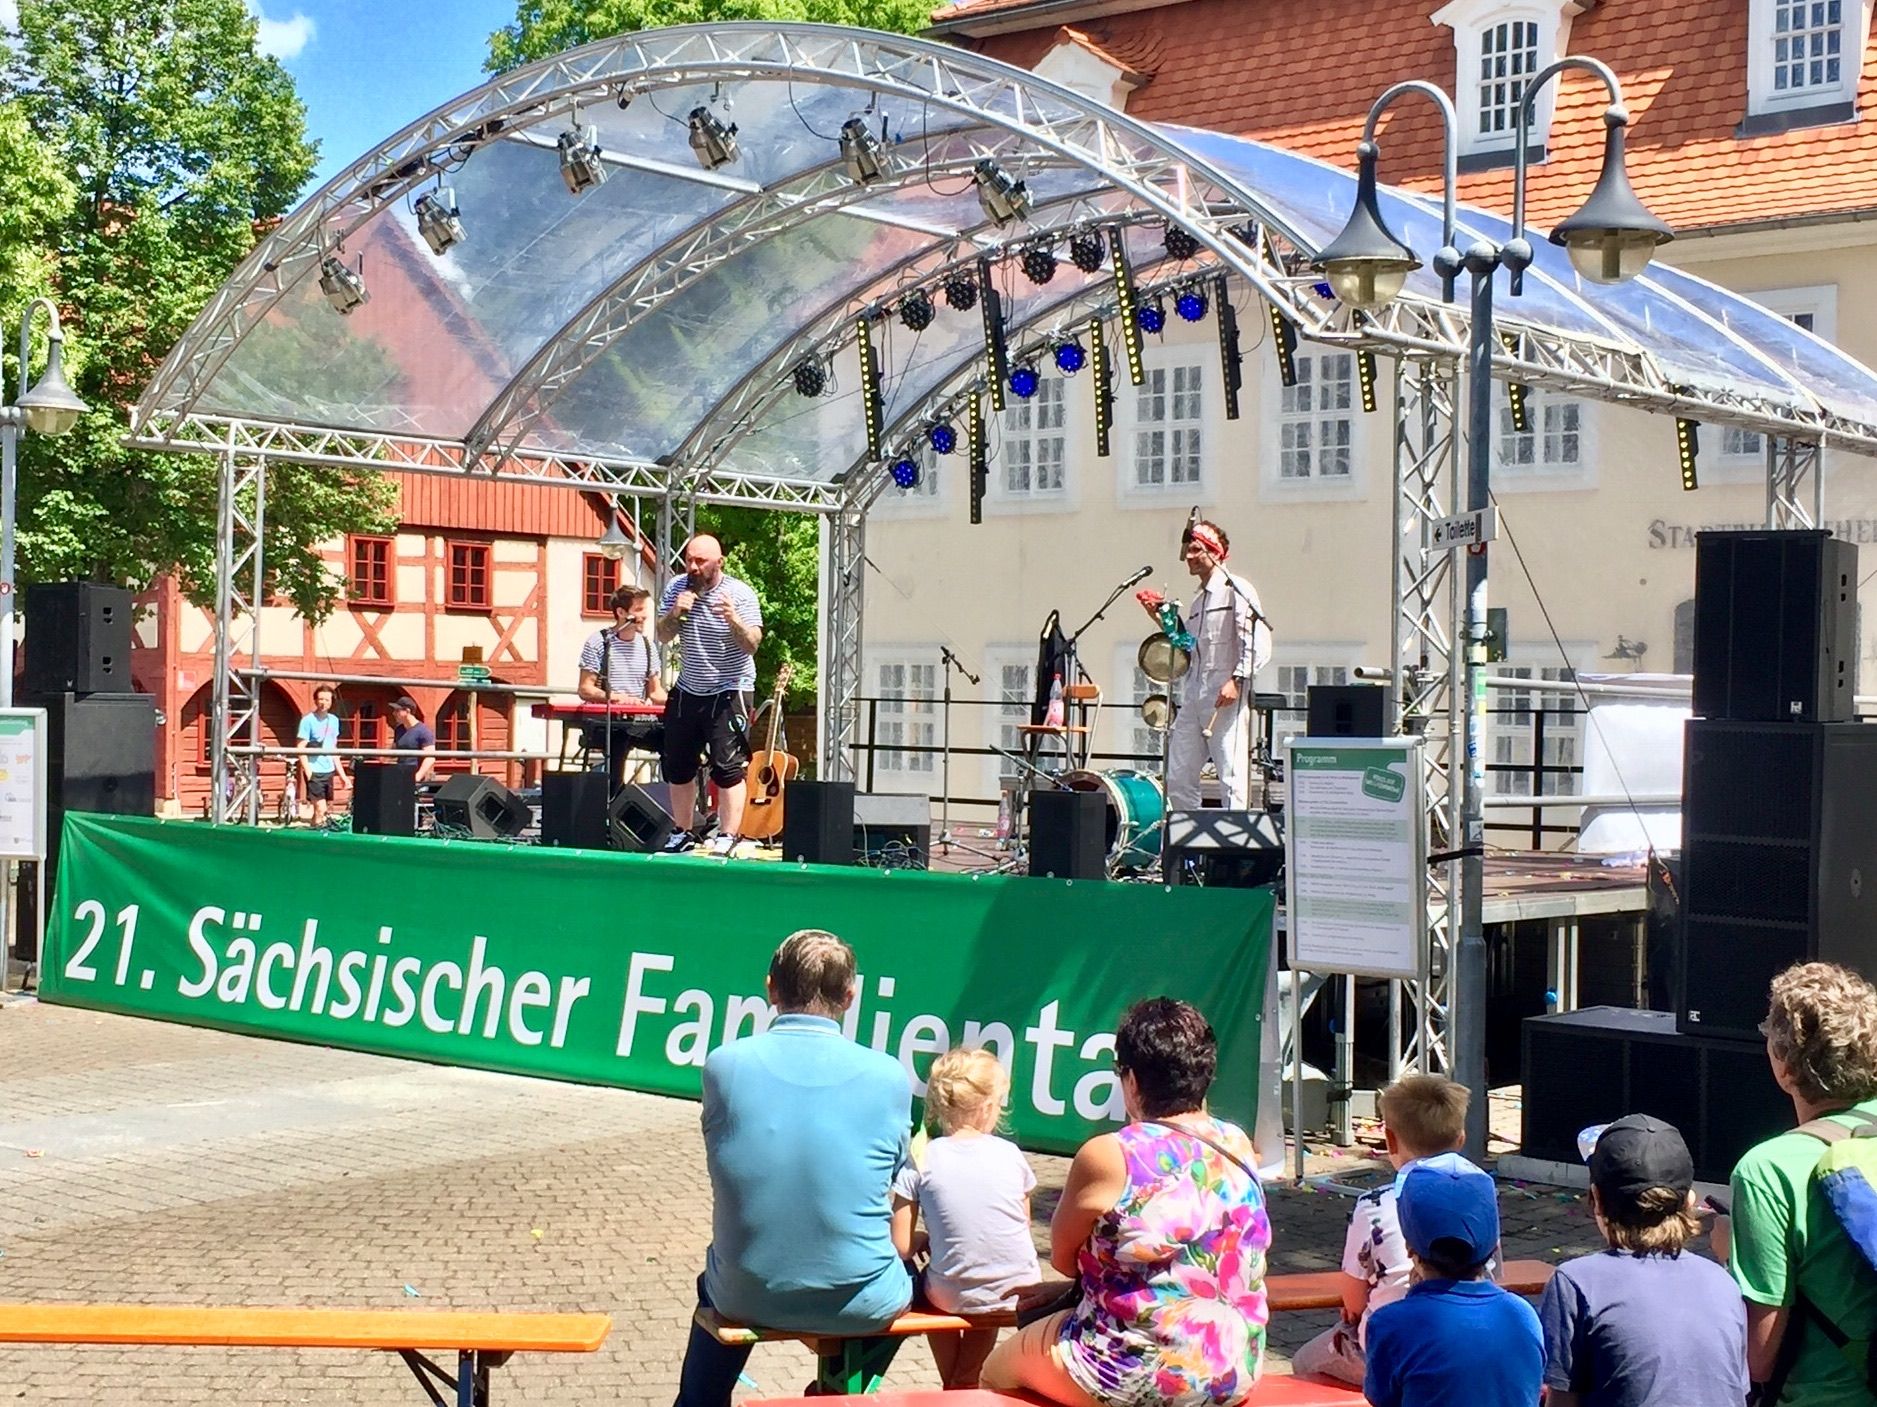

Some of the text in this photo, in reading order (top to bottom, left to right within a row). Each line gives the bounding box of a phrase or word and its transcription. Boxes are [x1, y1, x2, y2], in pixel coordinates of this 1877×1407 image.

[1296, 752, 1337, 766] Programm
[65, 900, 155, 990] 21.
[178, 906, 591, 1048] Sächsischer
